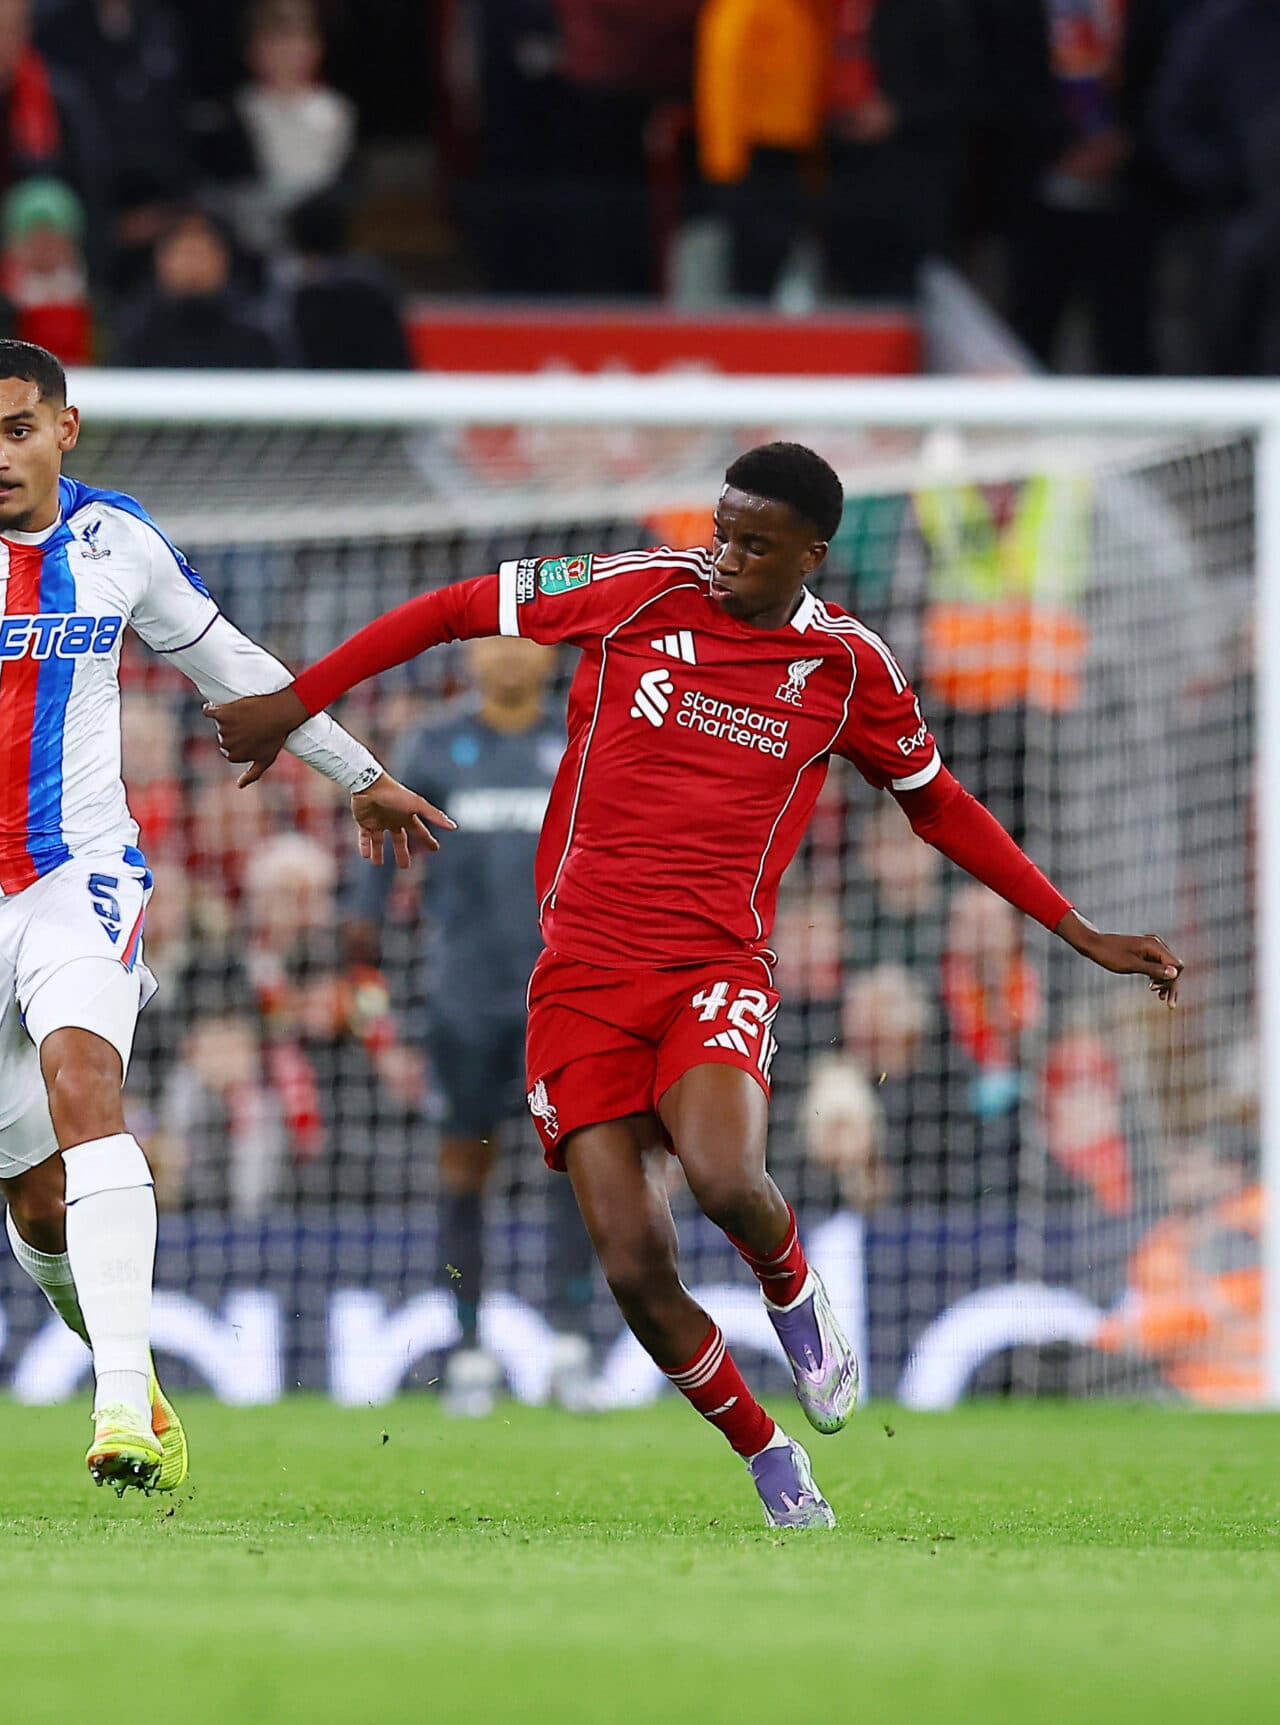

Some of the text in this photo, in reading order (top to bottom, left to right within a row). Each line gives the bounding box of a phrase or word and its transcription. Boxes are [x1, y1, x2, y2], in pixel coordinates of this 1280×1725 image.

[676, 709, 788, 759] chartered
[681, 691, 789, 739] standard
[87, 872, 121, 922] 5
[691, 981, 768, 1039] 42
